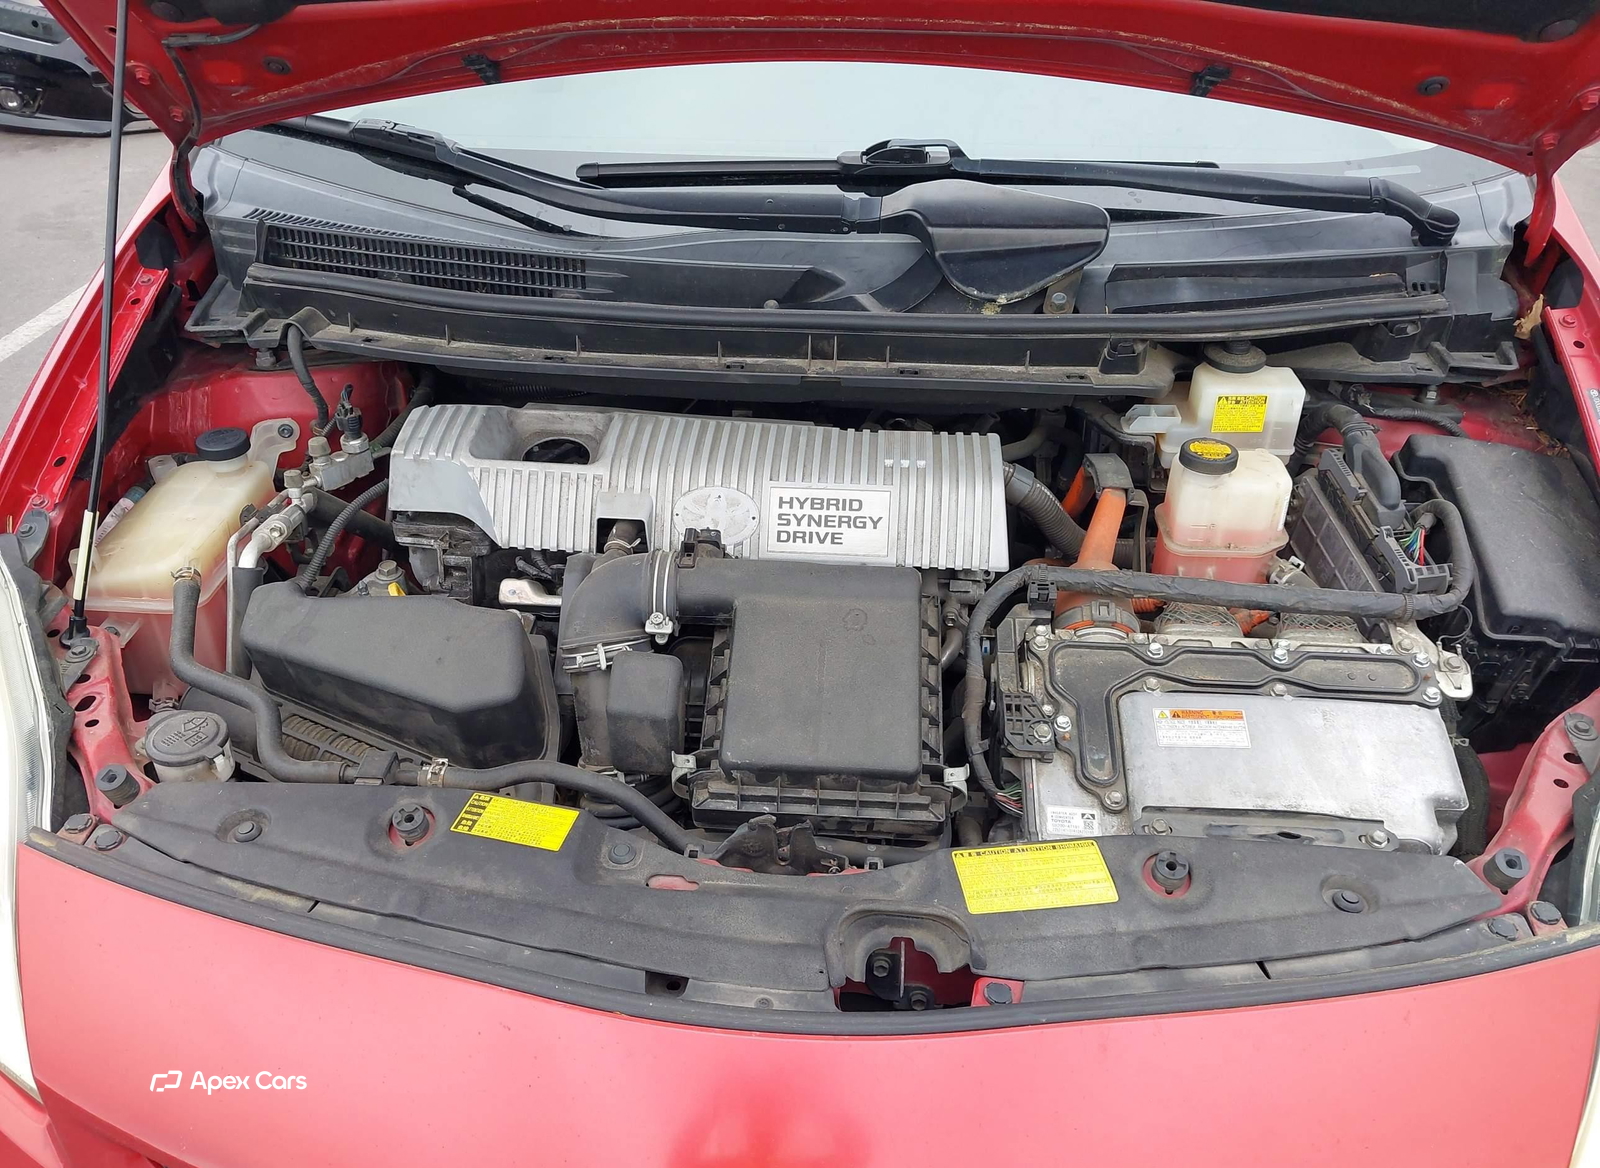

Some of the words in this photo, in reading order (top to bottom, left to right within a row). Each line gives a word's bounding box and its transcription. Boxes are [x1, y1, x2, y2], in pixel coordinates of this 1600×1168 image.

[778, 496, 863, 512] HYBRID
[777, 513, 884, 530] SYNERGY
[776, 530, 844, 545] DRIVE
[981, 848, 1011, 856] CAUTION
[1014, 845, 1052, 853] ATTENTION
